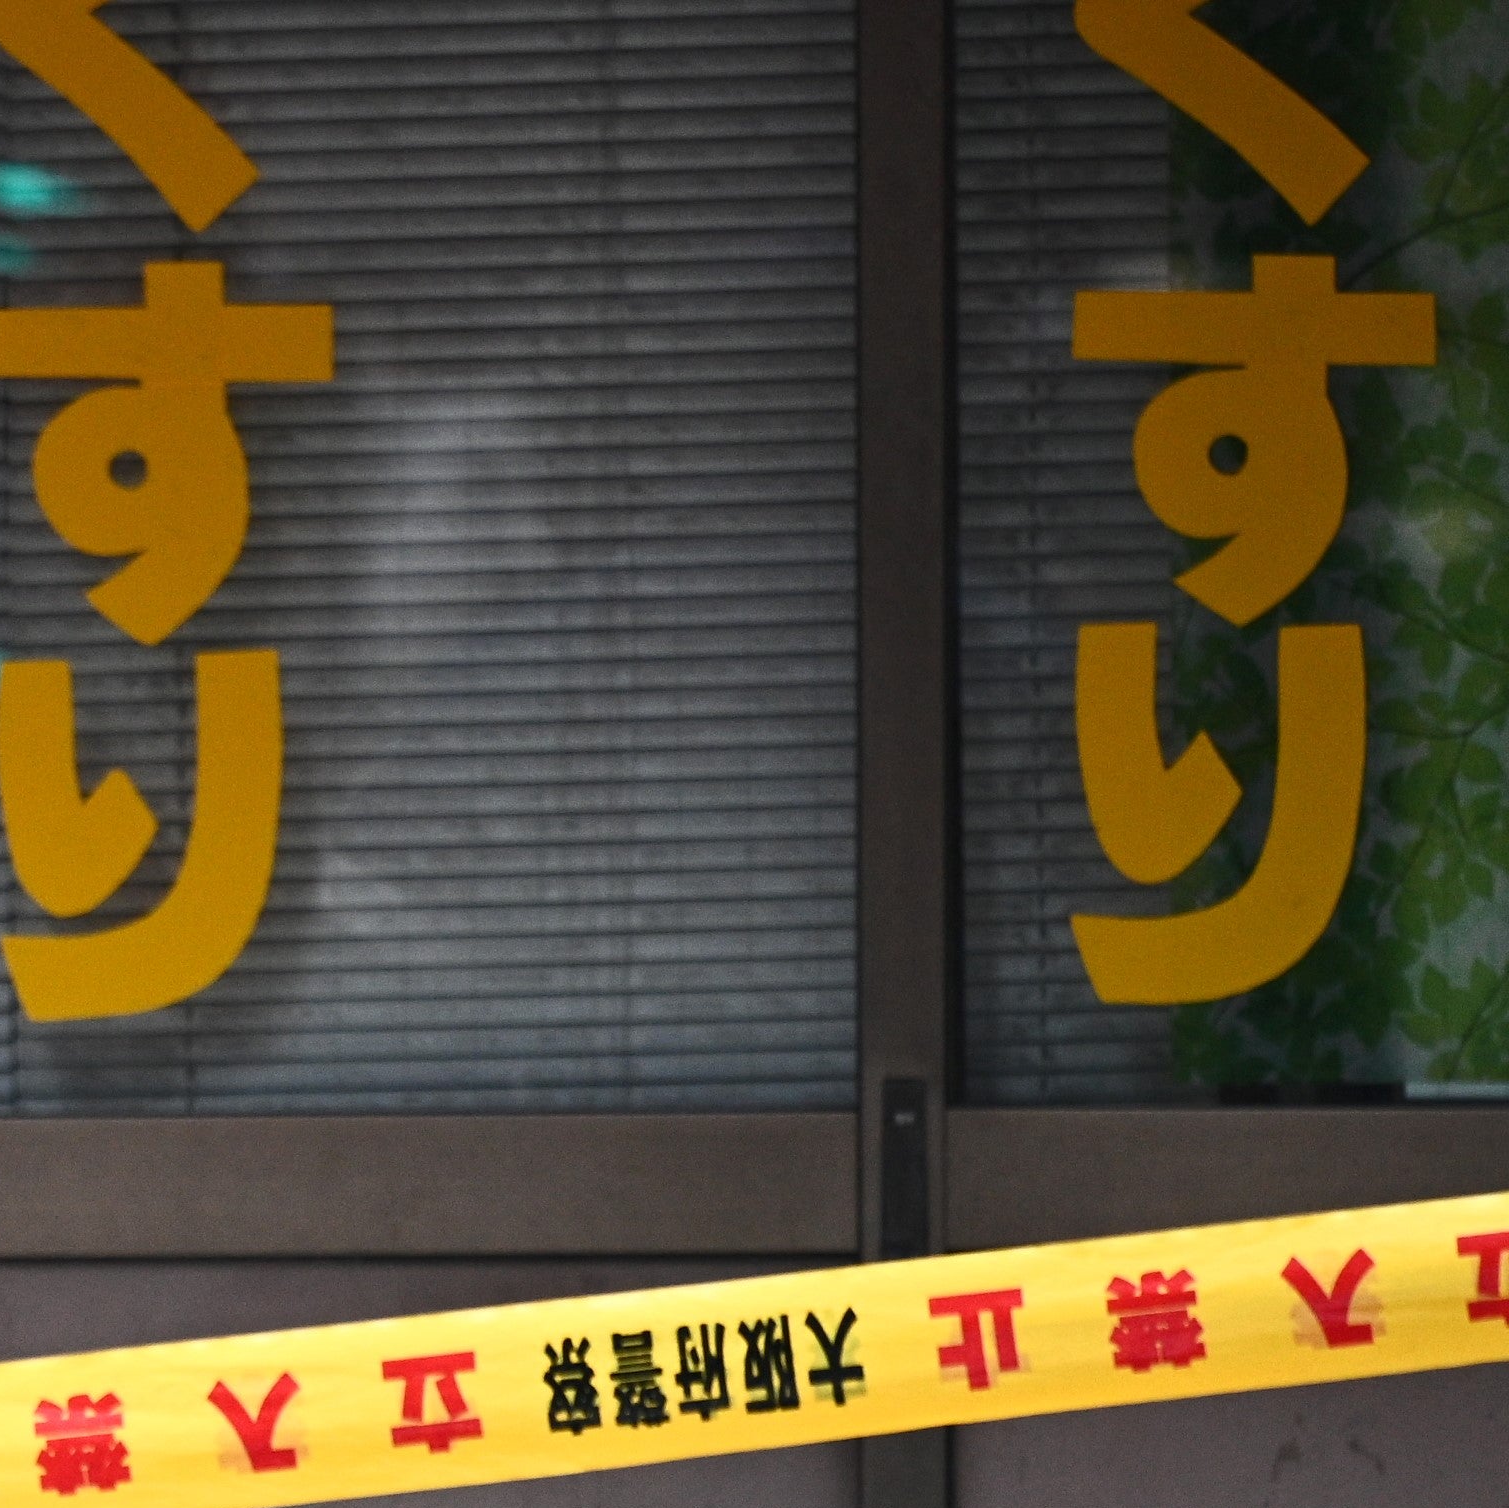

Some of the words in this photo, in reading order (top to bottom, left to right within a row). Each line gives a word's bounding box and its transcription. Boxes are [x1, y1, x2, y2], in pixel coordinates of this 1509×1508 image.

[542, 1306, 867, 1436] 大阪府警察
